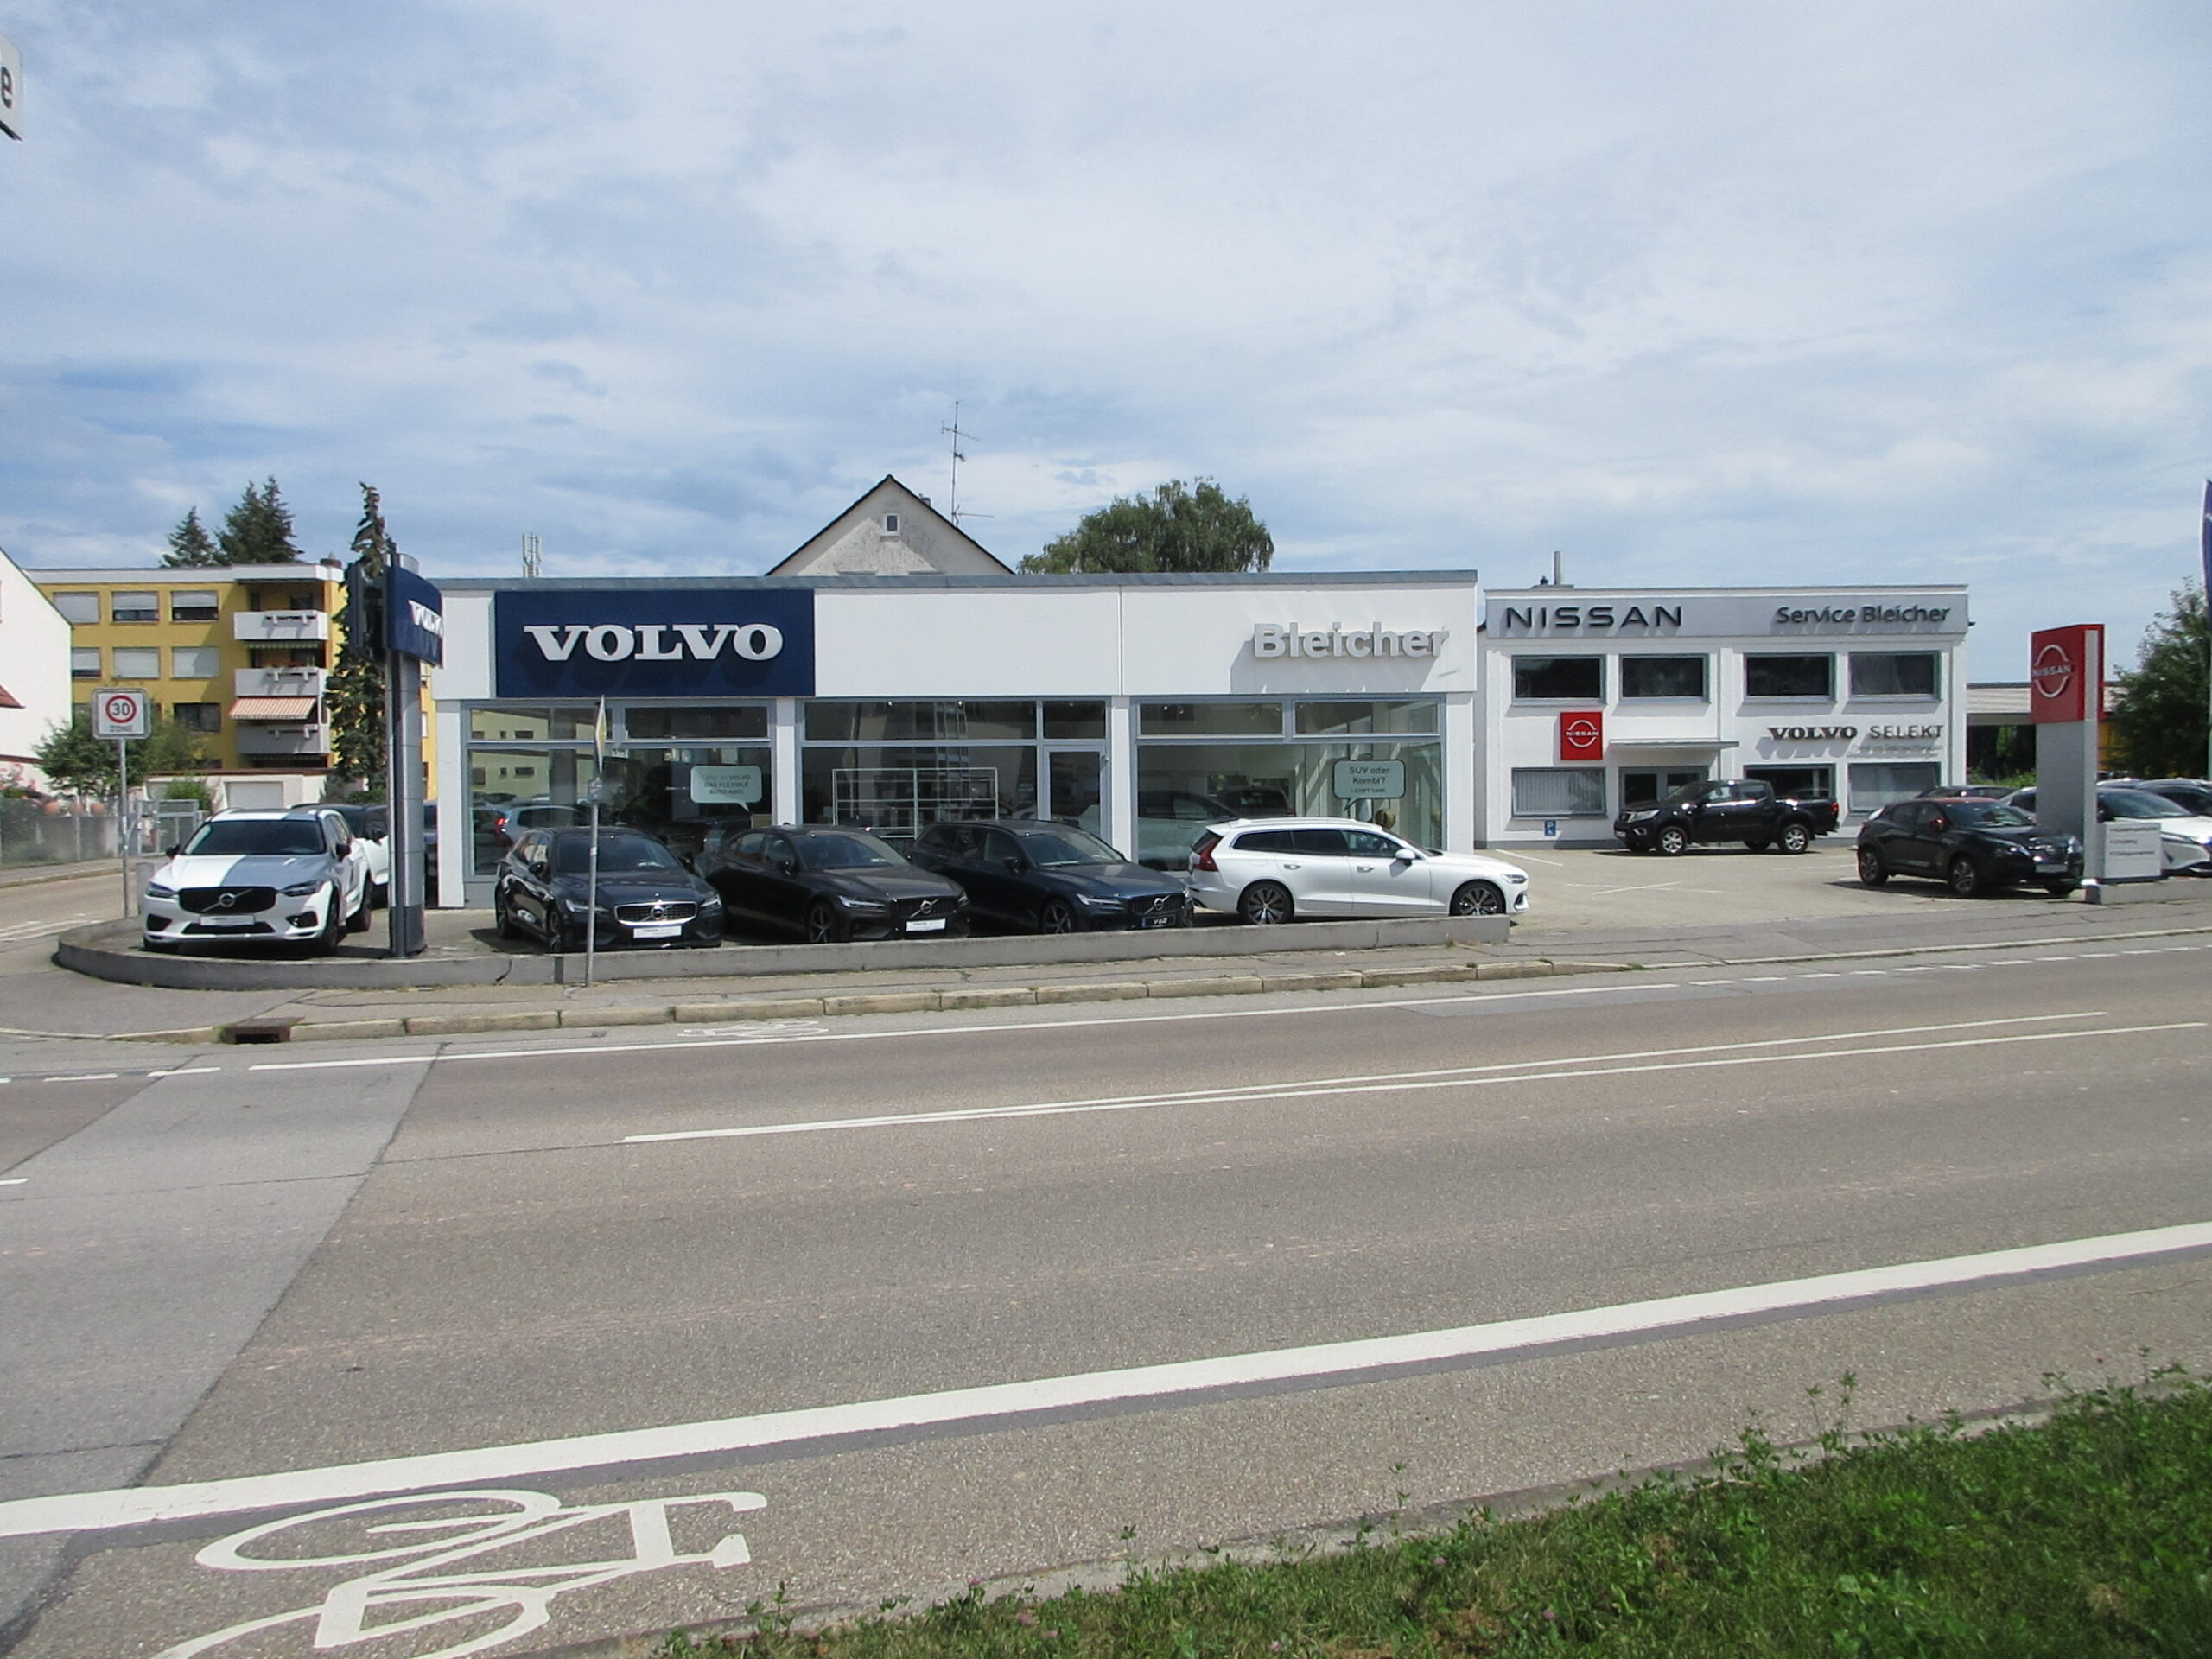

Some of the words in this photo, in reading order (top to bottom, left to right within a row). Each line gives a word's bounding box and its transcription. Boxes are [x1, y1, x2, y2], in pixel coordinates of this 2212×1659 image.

[408, 599, 442, 638] VOLV
[1506, 606, 1682, 629] NISSAN
[1777, 606, 1857, 623] Service
[1861, 604, 1951, 623] Bleicher
[524, 624, 783, 661] VOLVO
[1254, 621, 1451, 658] Bleicher
[2031, 664, 2072, 677] NISSAN
[112, 702, 130, 715] 30
[1766, 726, 1859, 741] VOLVO
[1870, 725, 1944, 739] SELEKT
[1349, 766, 1369, 774] SUV
[1352, 776, 1386, 785] Kombi?
